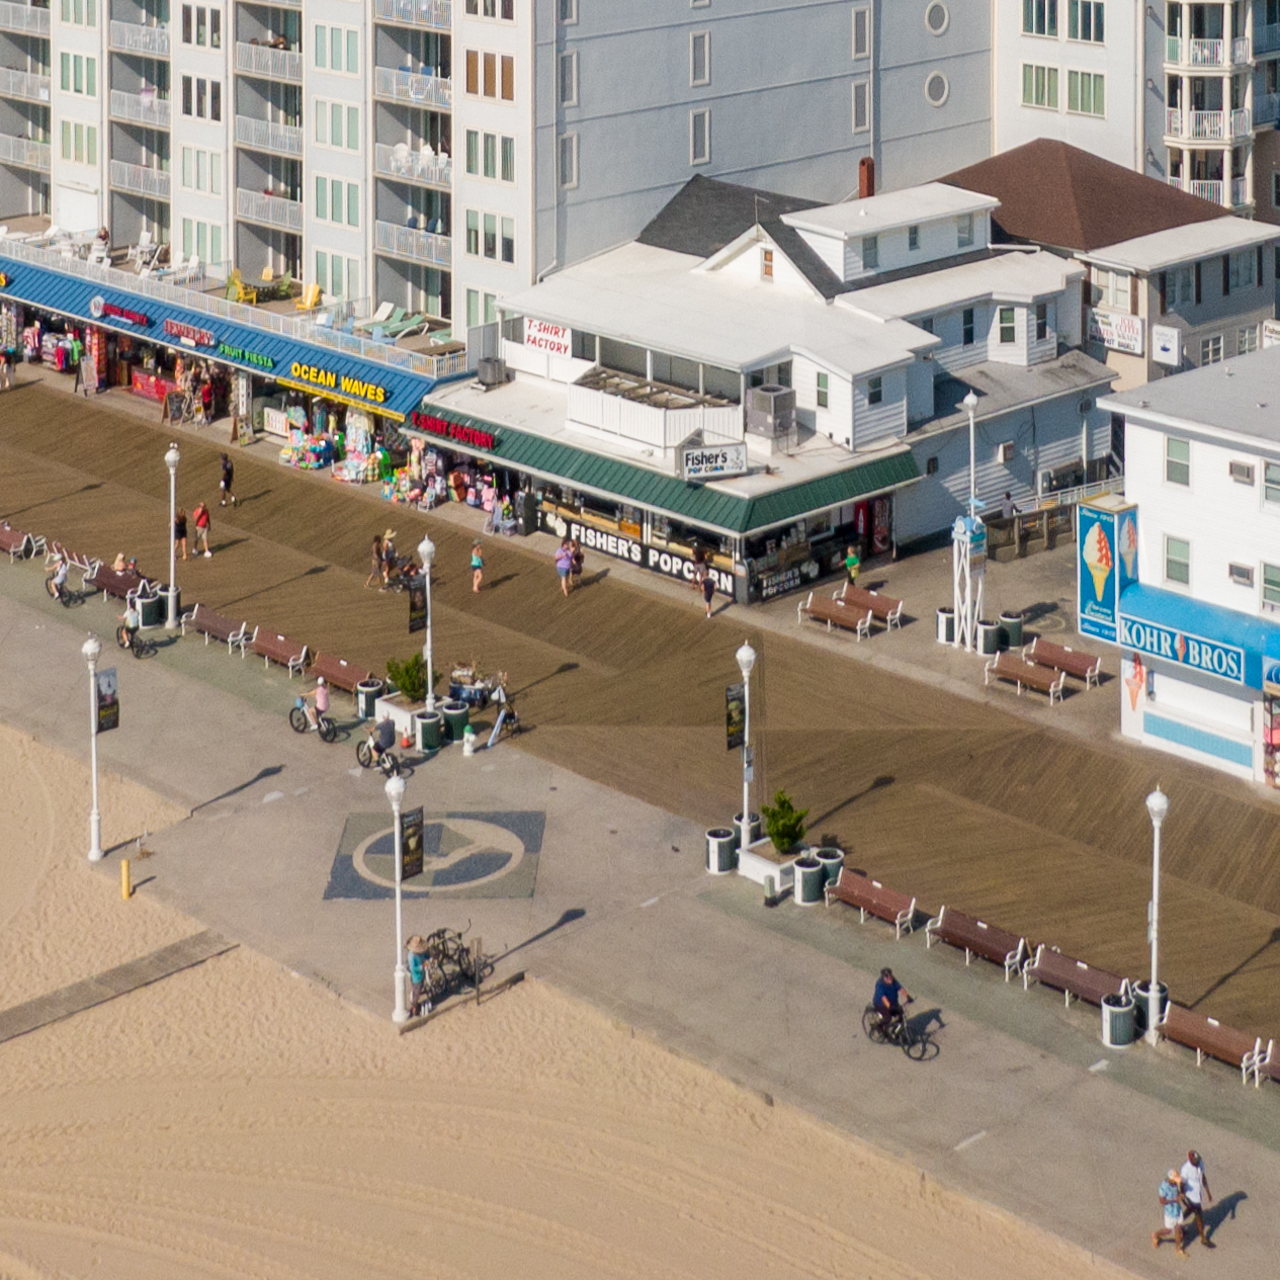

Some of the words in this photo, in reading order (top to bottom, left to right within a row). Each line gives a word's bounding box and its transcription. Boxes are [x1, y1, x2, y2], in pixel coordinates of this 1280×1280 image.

[164, 318, 214, 346] JEWELRY
[528, 319, 568, 339] T-SHIRT
[220, 343, 243, 359] FRUIT
[245, 351, 274, 369] FIESTA
[527, 334, 569, 355] FACTORY
[291, 362, 336, 388] OCEAN
[341, 376, 386, 403] WAVES
[412, 411, 448, 435] T-SHIRT
[451, 423, 494, 450] FACTORY
[685, 449, 727, 467] Fisher's
[571, 521, 642, 563] FISHER'S
[649, 550, 733, 594] POPCRN
[762, 568, 800, 588] FISHER'S
[762, 577, 801, 598] POPCORN
[1120, 619, 1173, 658] KOHR
